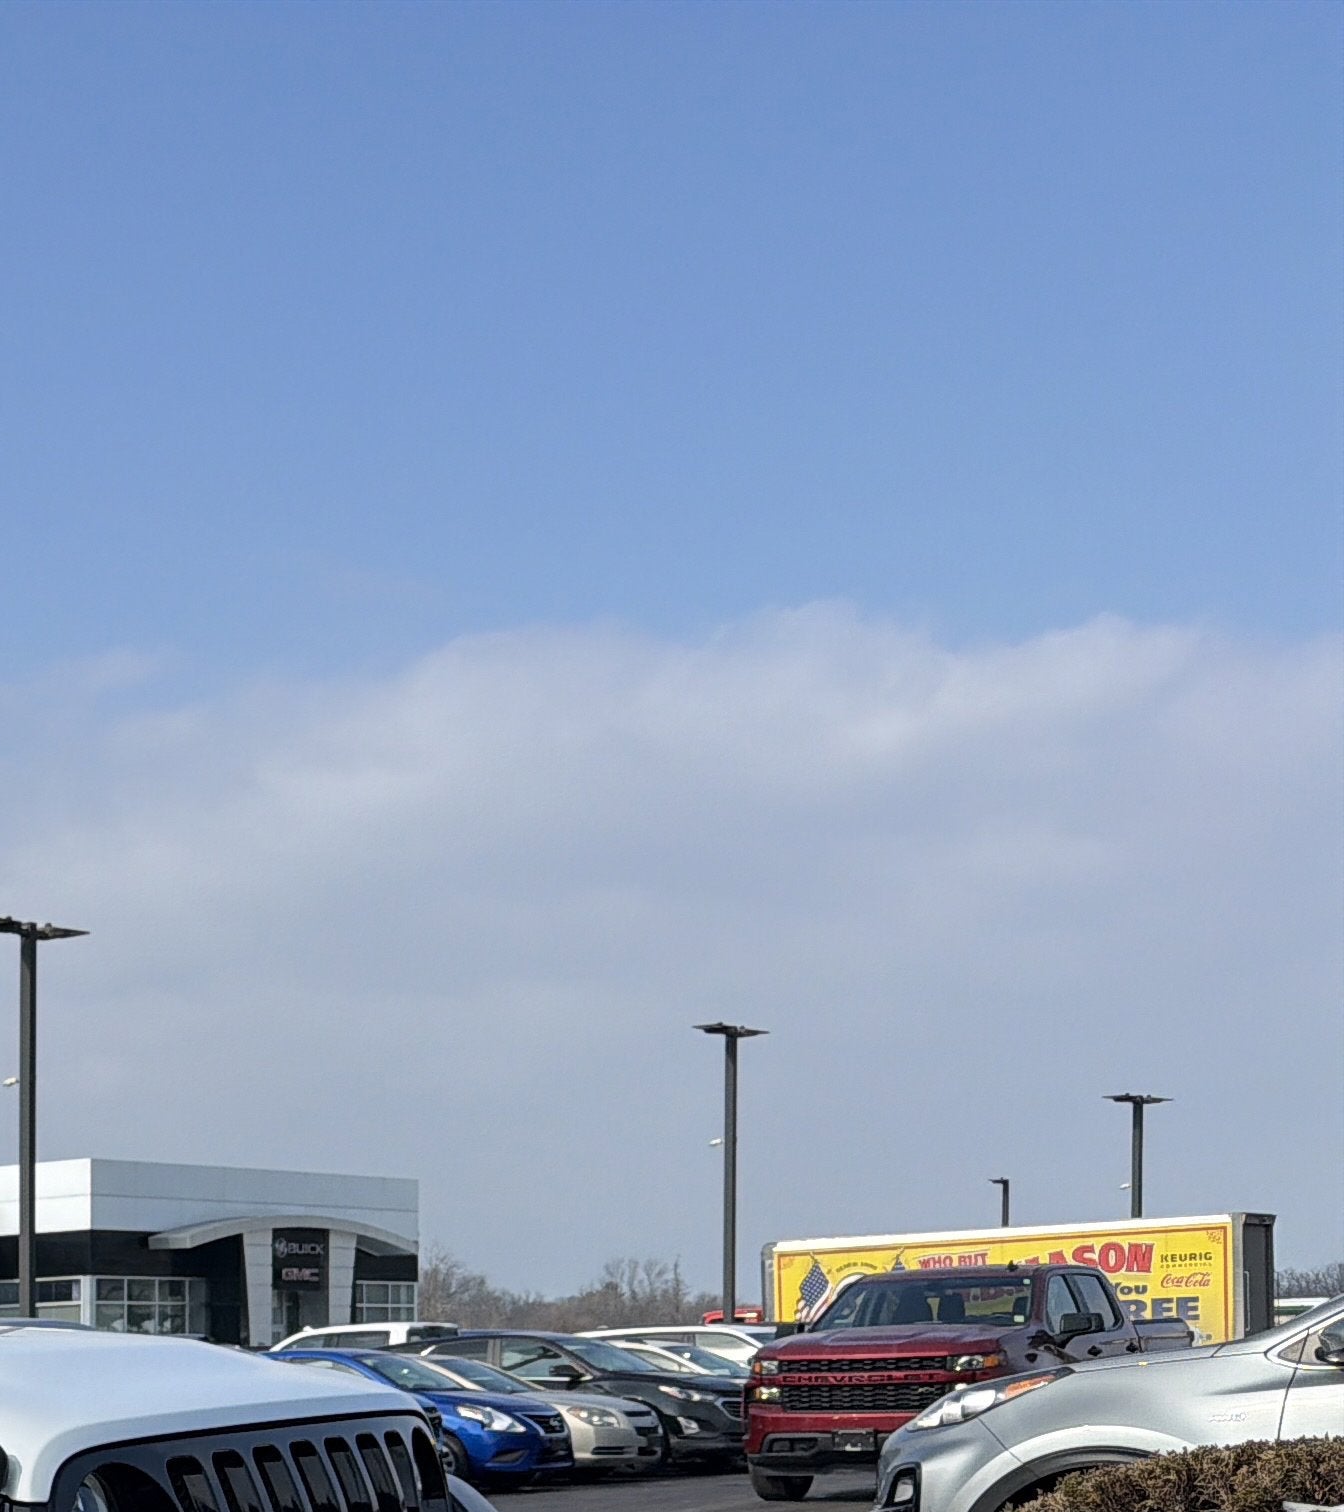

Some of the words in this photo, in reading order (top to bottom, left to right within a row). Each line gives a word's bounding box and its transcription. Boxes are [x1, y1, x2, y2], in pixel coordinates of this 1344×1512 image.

[288, 1242, 324, 1255] BUICK
[918, 1255, 953, 1269] WHO
[958, 1252, 988, 1267] BUT
[1160, 1252, 1212, 1263] KEURIG
[281, 1267, 319, 1282] GMC
[1120, 1296, 1200, 1320] REE
[782, 1373, 940, 1384] CHEVROLET
